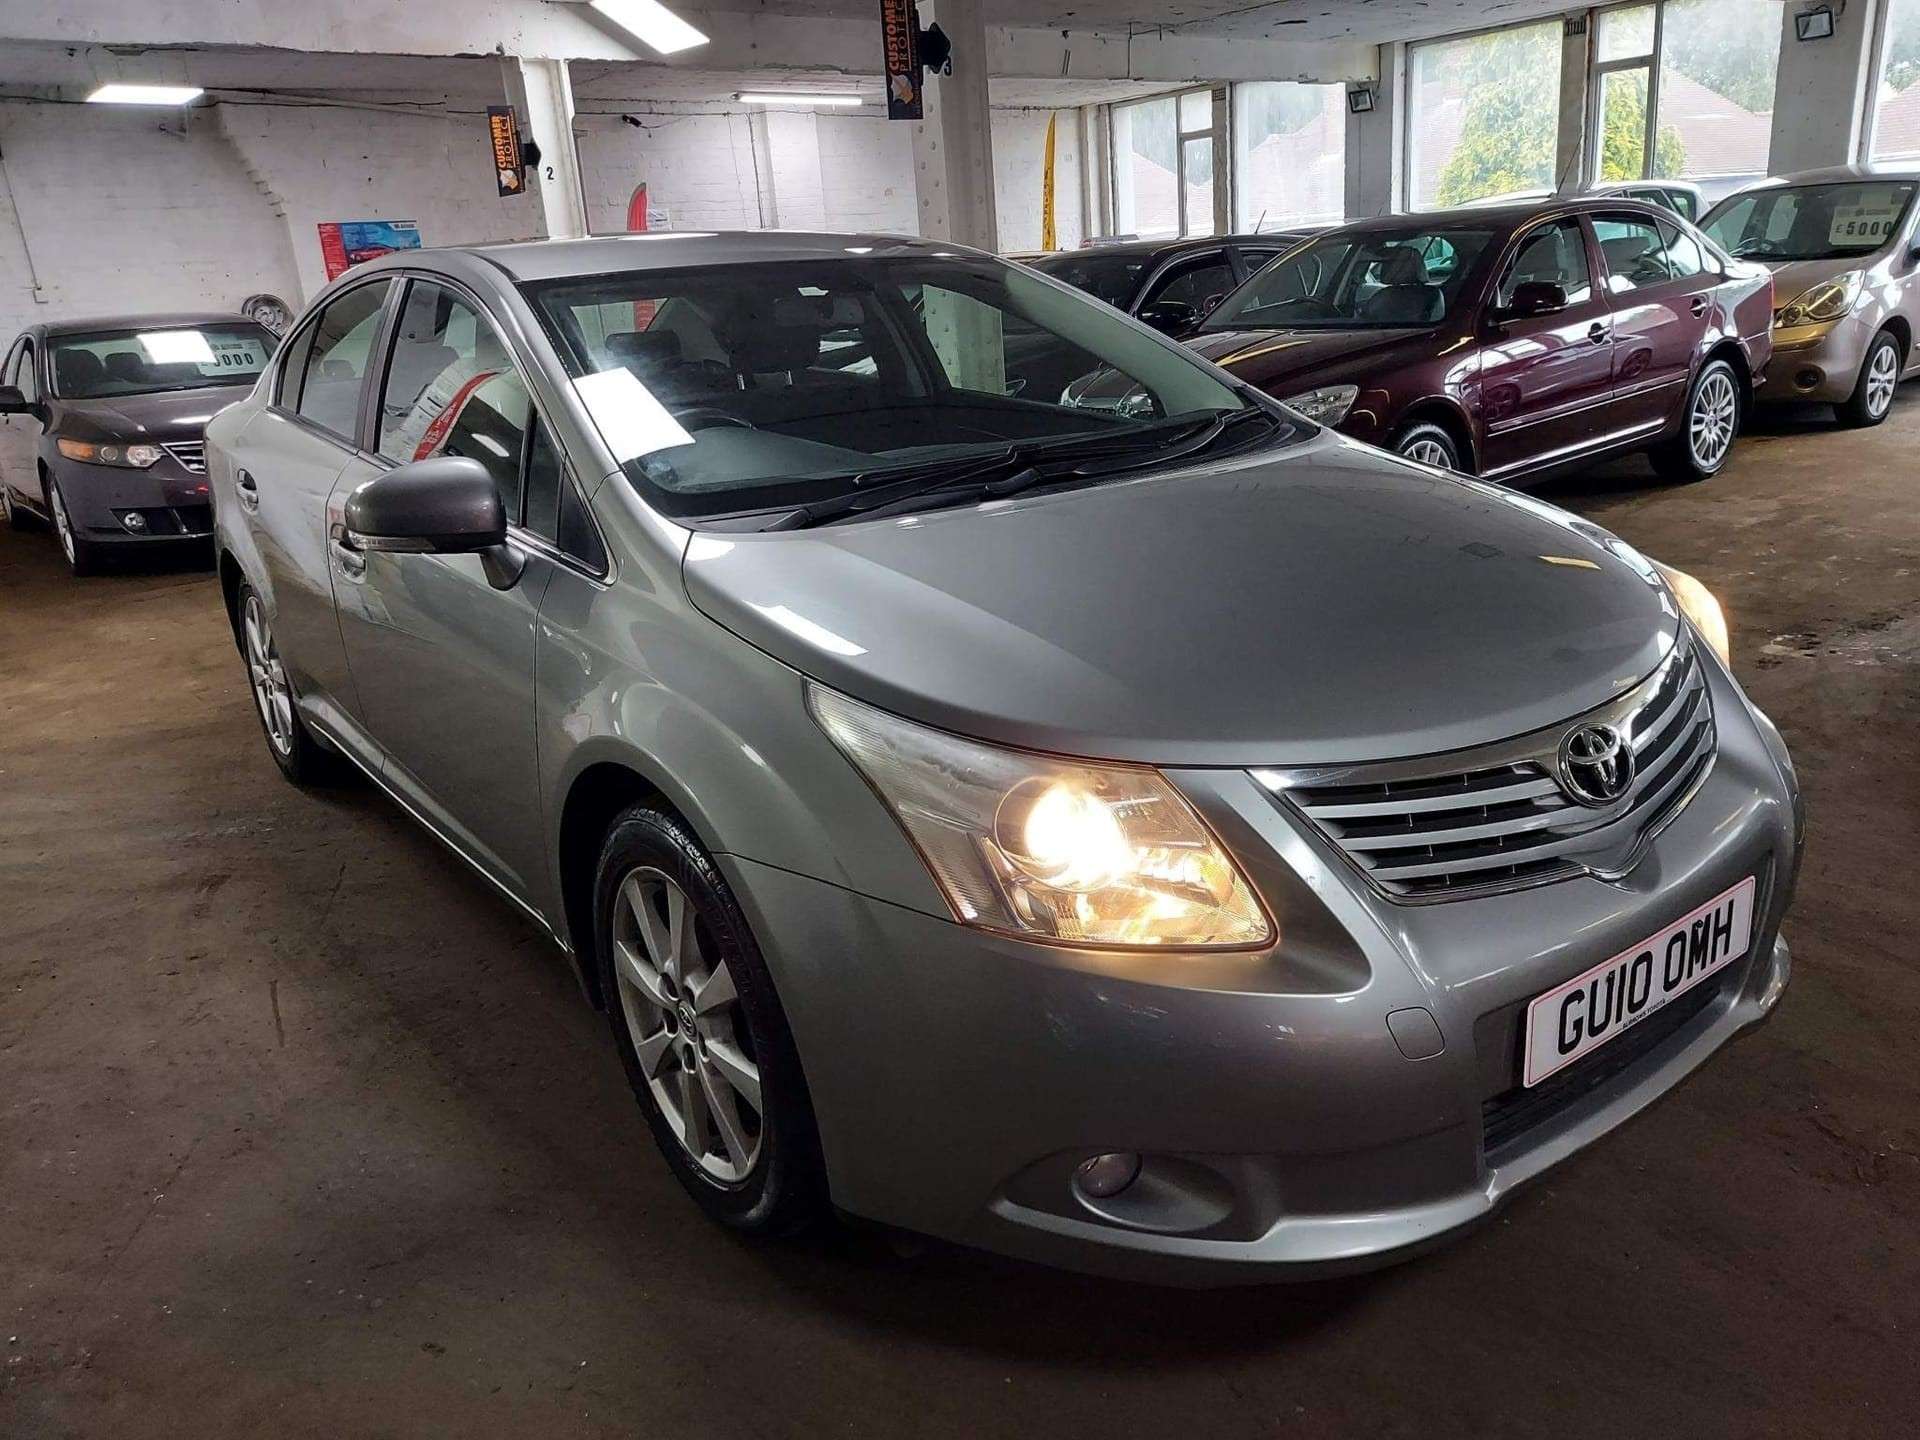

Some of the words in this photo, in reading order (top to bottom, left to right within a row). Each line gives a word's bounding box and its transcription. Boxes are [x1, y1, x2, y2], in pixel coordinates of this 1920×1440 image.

[491, 114, 507, 168] CUSTOMER
[501, 116, 514, 168] PROTECT
[546, 166, 554, 180] 2
[1558, 951, 1653, 1055] GU10
[1663, 899, 1734, 993] OMH
